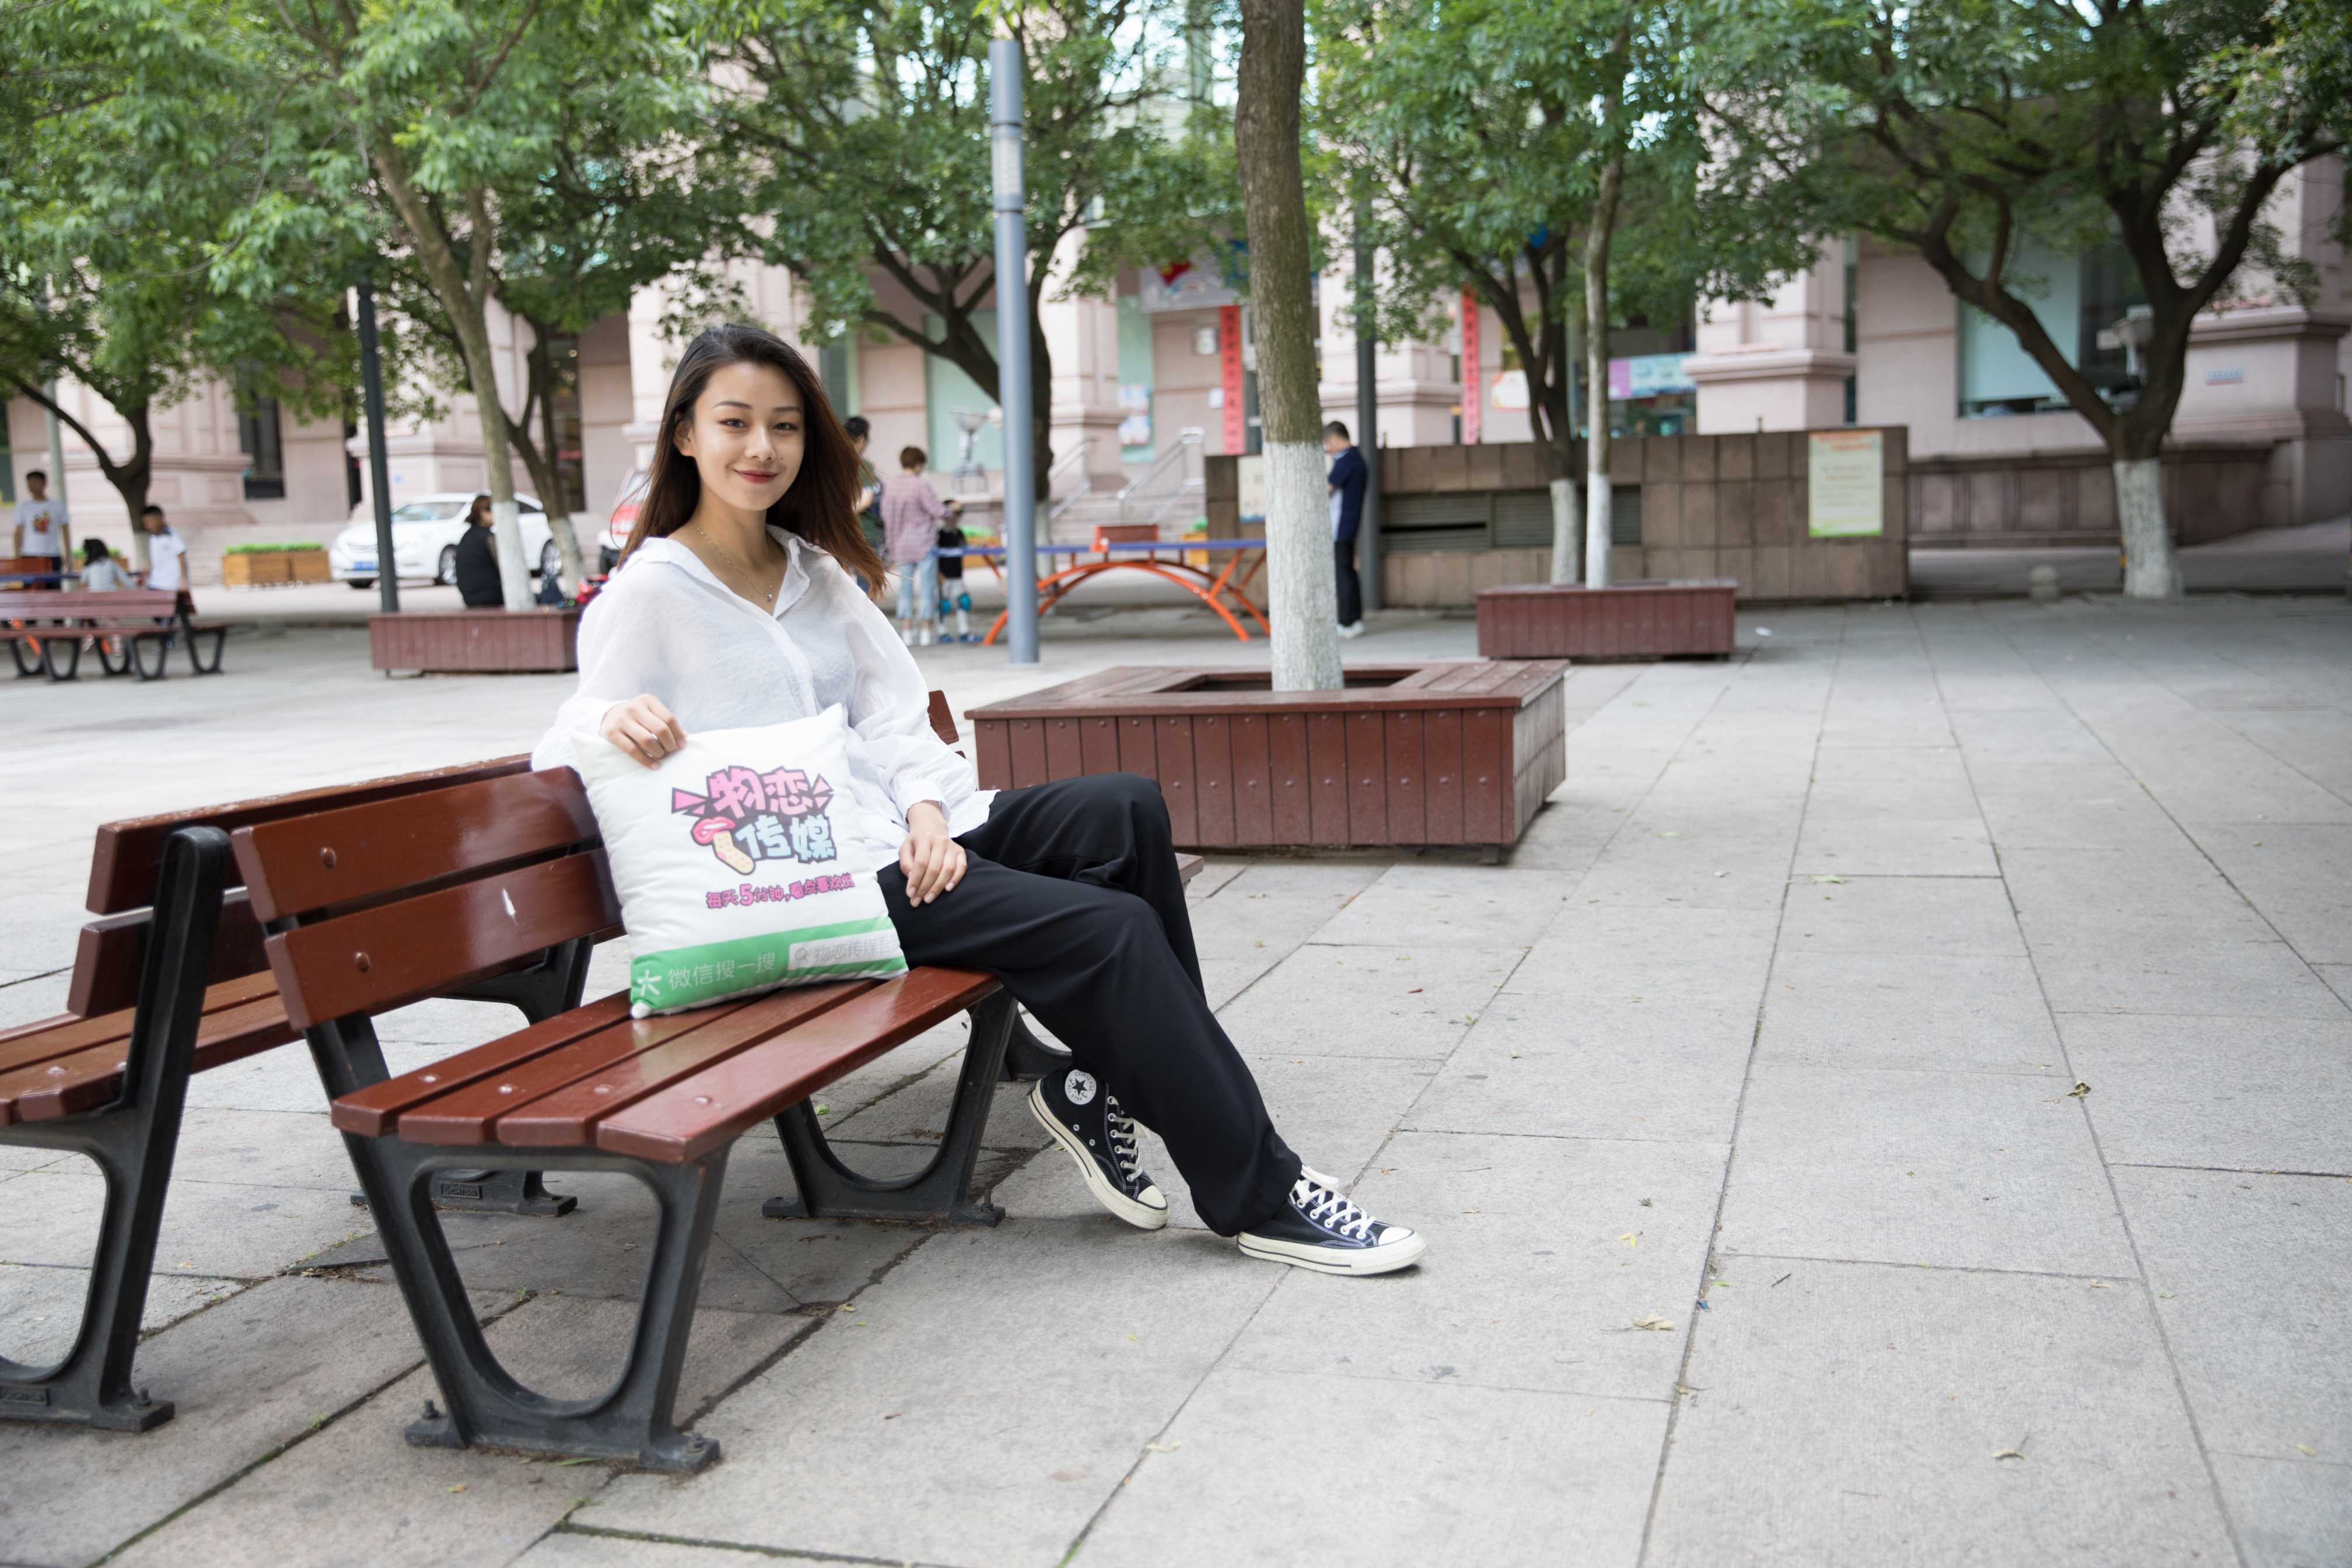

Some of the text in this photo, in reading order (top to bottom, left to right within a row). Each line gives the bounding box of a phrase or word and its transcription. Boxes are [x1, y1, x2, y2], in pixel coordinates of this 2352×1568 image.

[708, 766, 814, 819] 物恋
[734, 814, 835, 862] 传媒
[668, 952, 775, 989] 微信搜一搜
